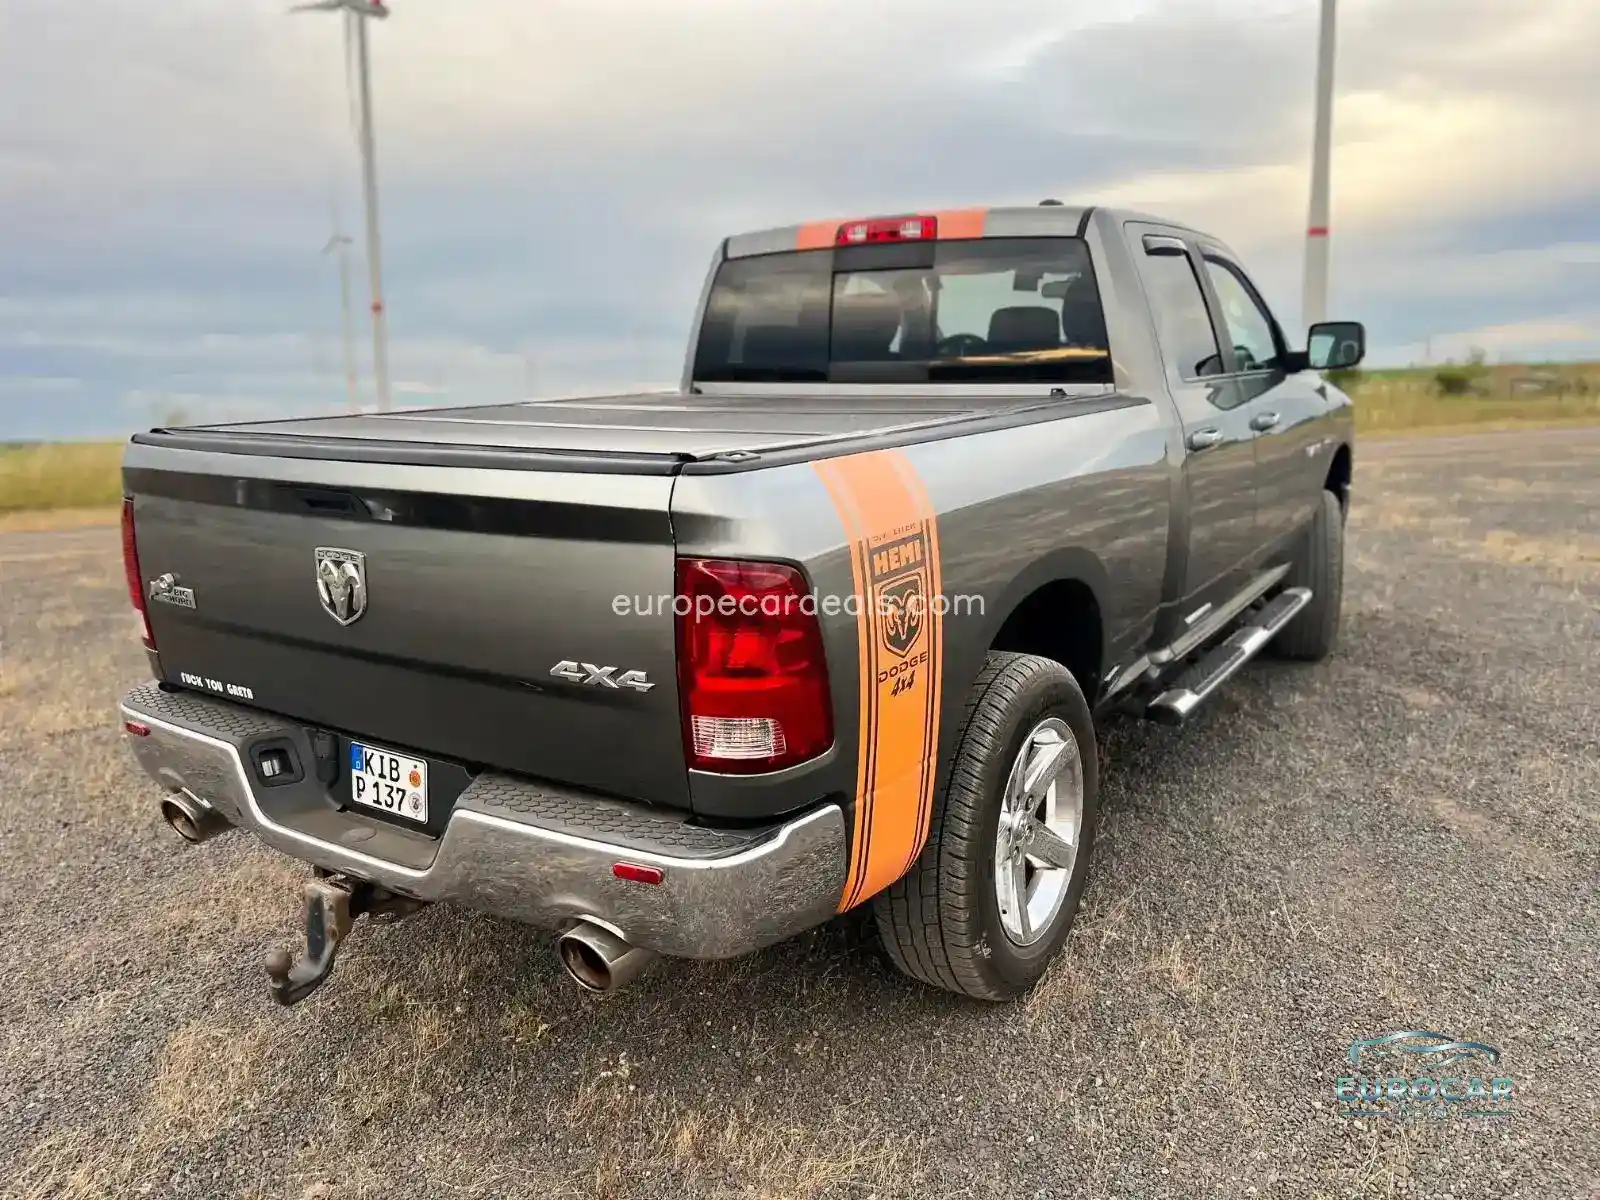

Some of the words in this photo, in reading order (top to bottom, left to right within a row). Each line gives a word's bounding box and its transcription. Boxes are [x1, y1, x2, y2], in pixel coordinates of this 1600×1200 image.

[873, 540, 921, 576] HEMI
[878, 651, 928, 684] DODGE
[205, 678, 223, 692] YOU
[226, 683, 253, 699] GRETA
[364, 751, 400, 782] KIB
[355, 775, 366, 798] P
[372, 781, 406, 811] 137
